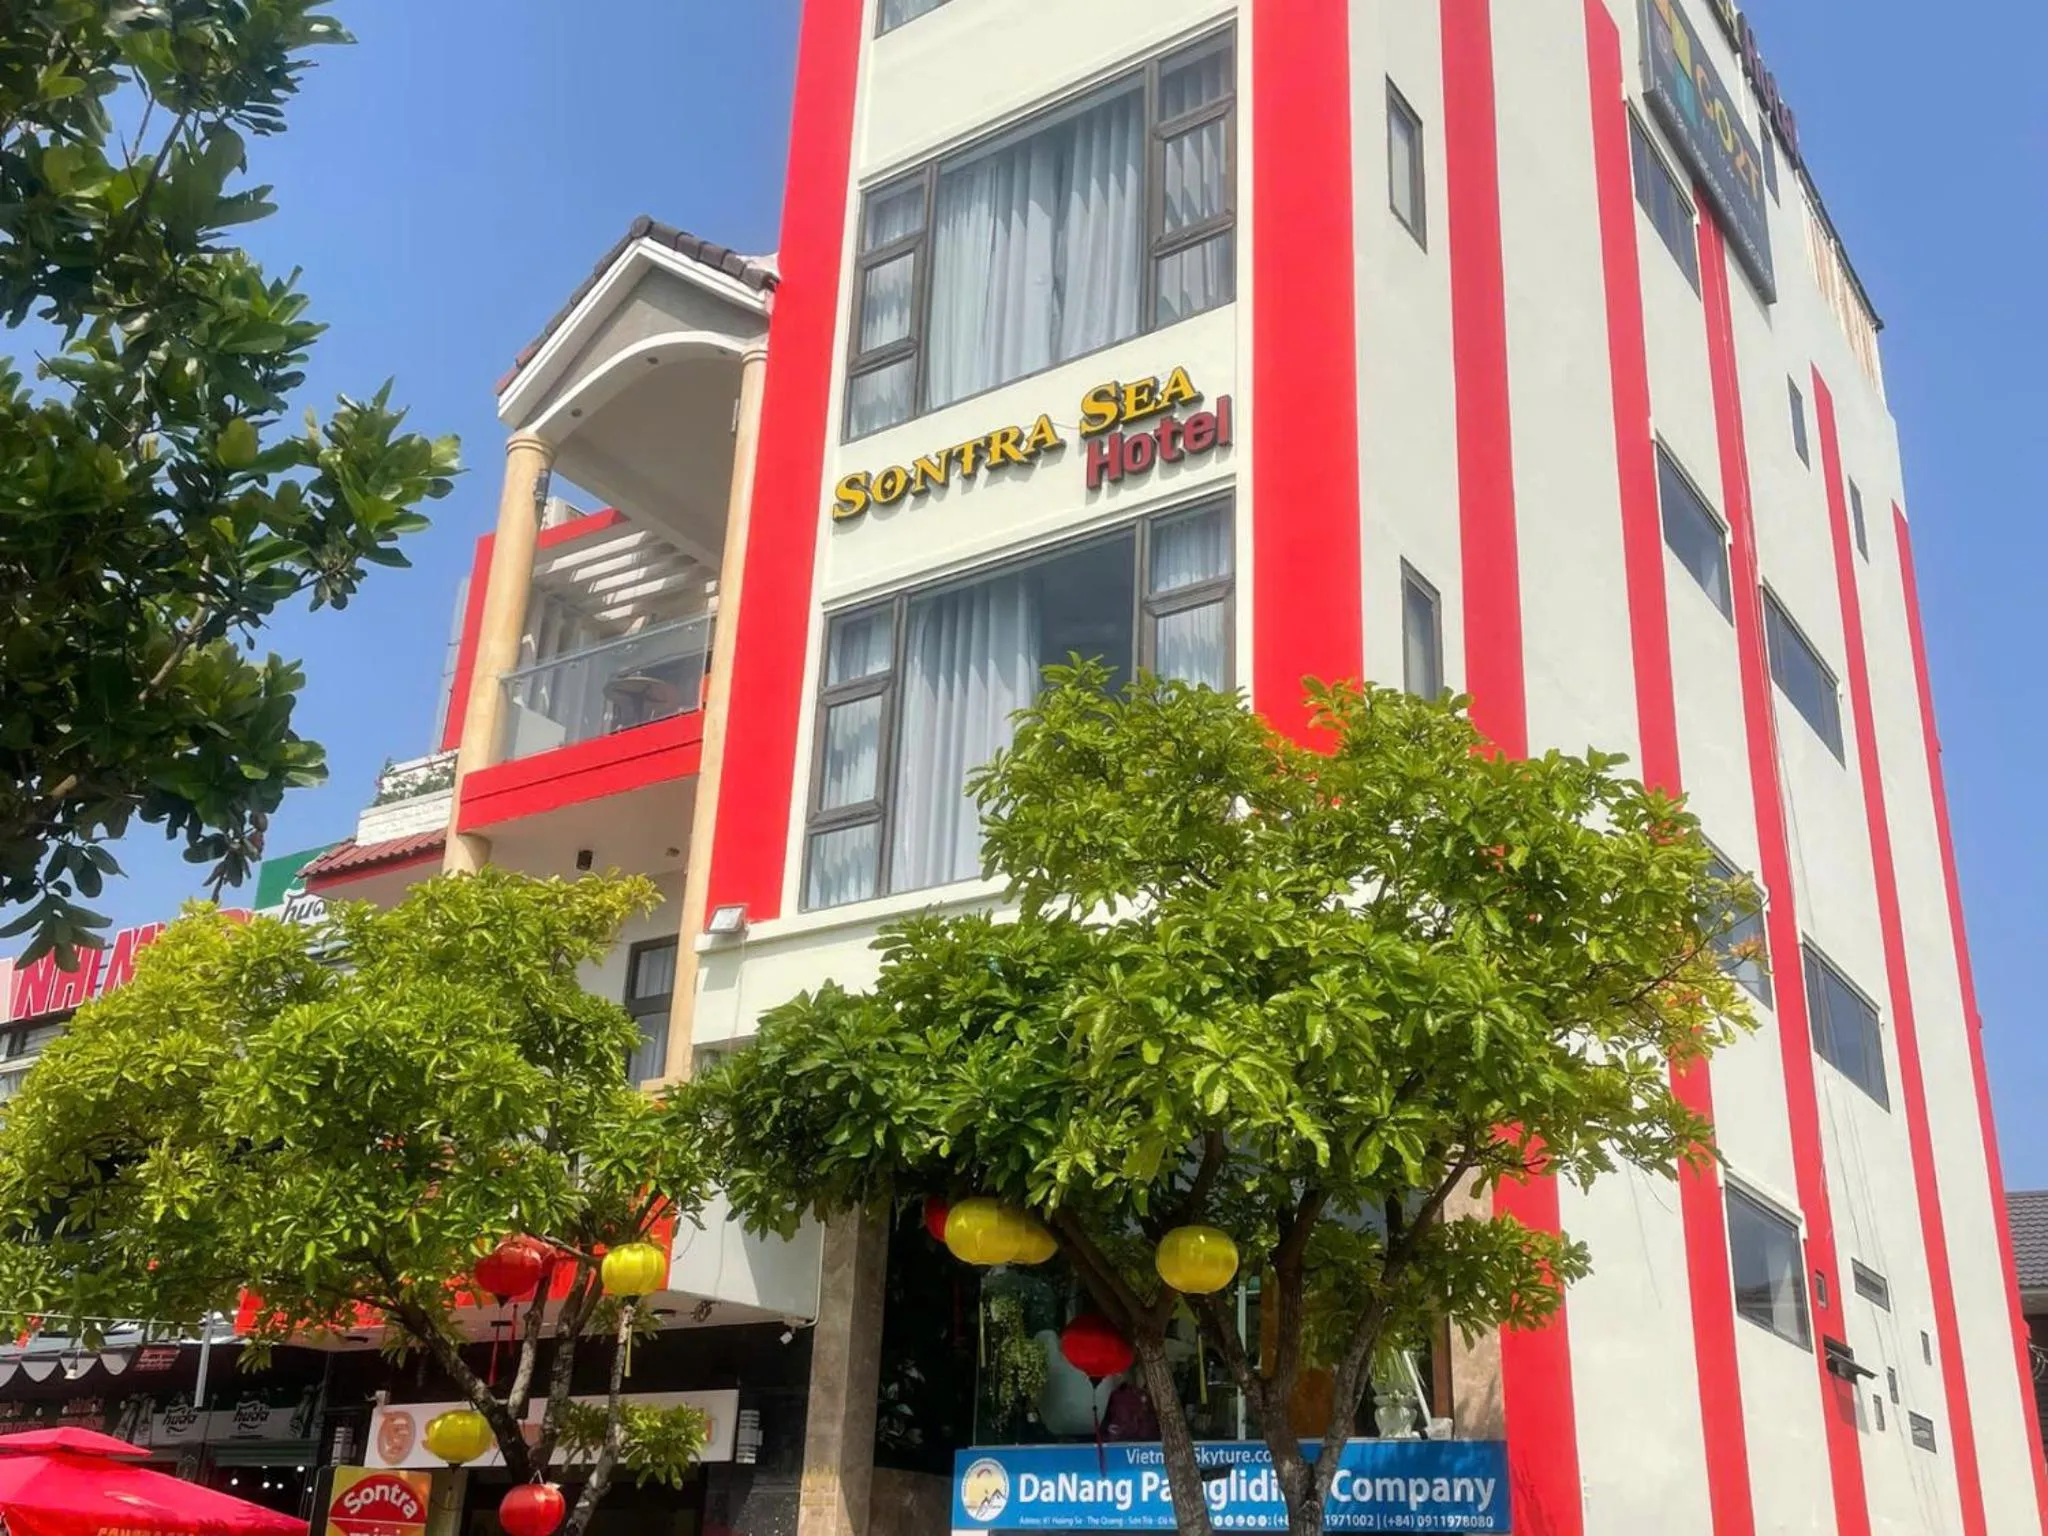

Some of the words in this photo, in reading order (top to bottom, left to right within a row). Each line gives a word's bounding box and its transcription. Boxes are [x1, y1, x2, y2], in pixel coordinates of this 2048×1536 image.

[832, 414, 1067, 521] SONTRA
[1080, 364, 1204, 436] SEA
[1086, 395, 1233, 489] Hotel
[343, 1484, 419, 1519] Sontra
[1019, 1473, 1132, 1510] DaNang
[1330, 1469, 1496, 1512] Company
